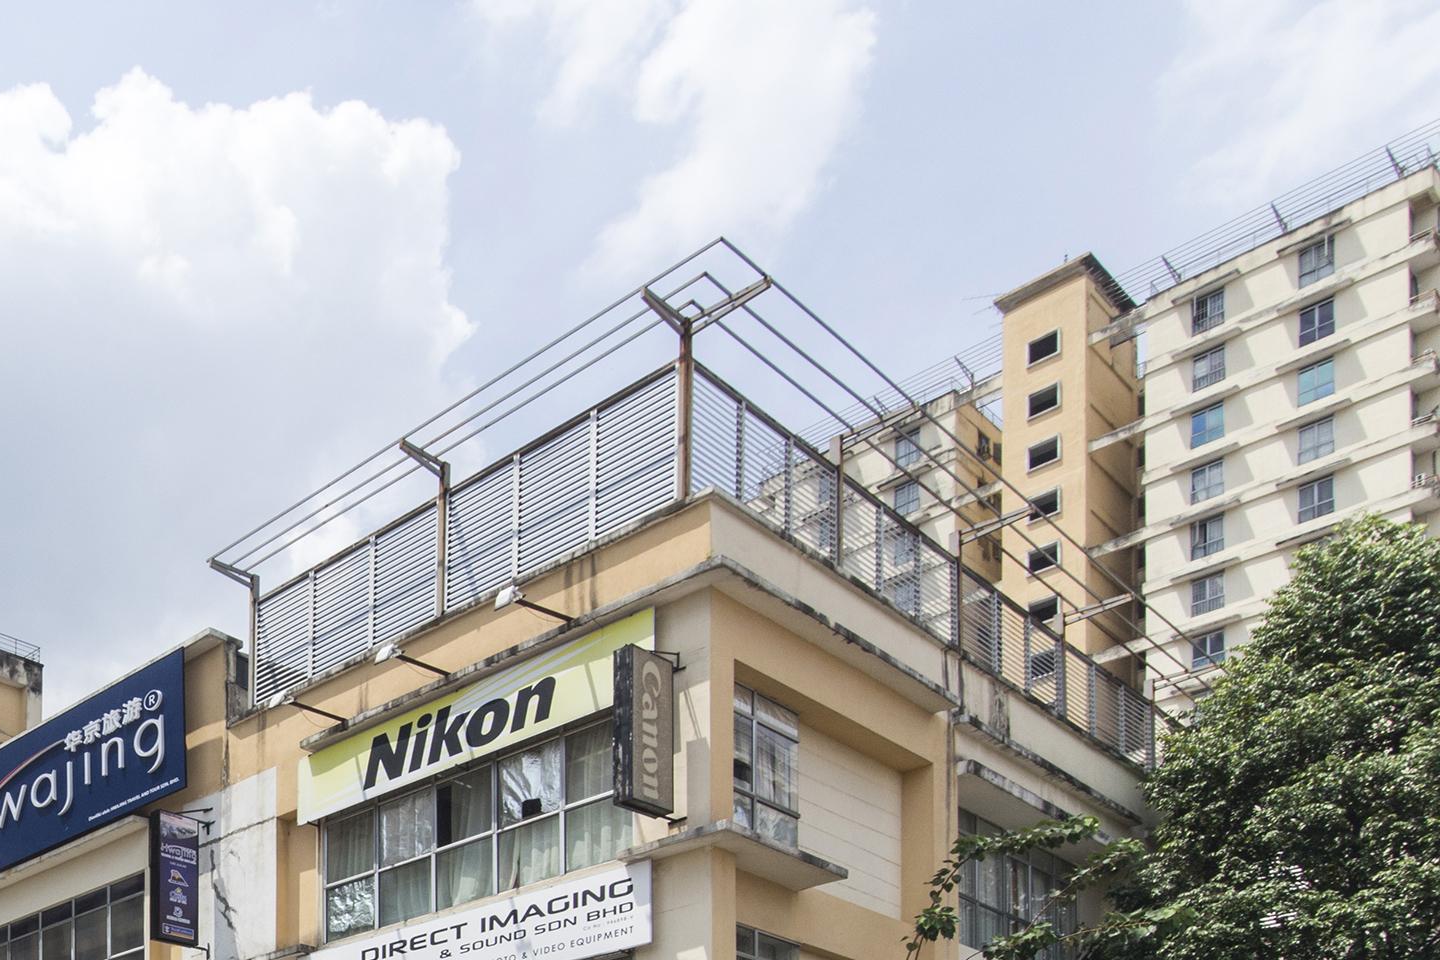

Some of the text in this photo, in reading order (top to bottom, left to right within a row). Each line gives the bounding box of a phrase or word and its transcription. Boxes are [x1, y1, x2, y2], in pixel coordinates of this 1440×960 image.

[63, 696, 143, 753] 华京旅游
[363, 675, 557, 791] Nikon
[641, 660, 661, 800] Canon
[439, 901, 635, 960] & SOUND SDN BHD
[479, 877, 635, 934] IMAGING
[521, 951, 529, 960] &
[532, 942, 566, 957] VIDEO
[569, 925, 635, 949] EQUIPMENT
